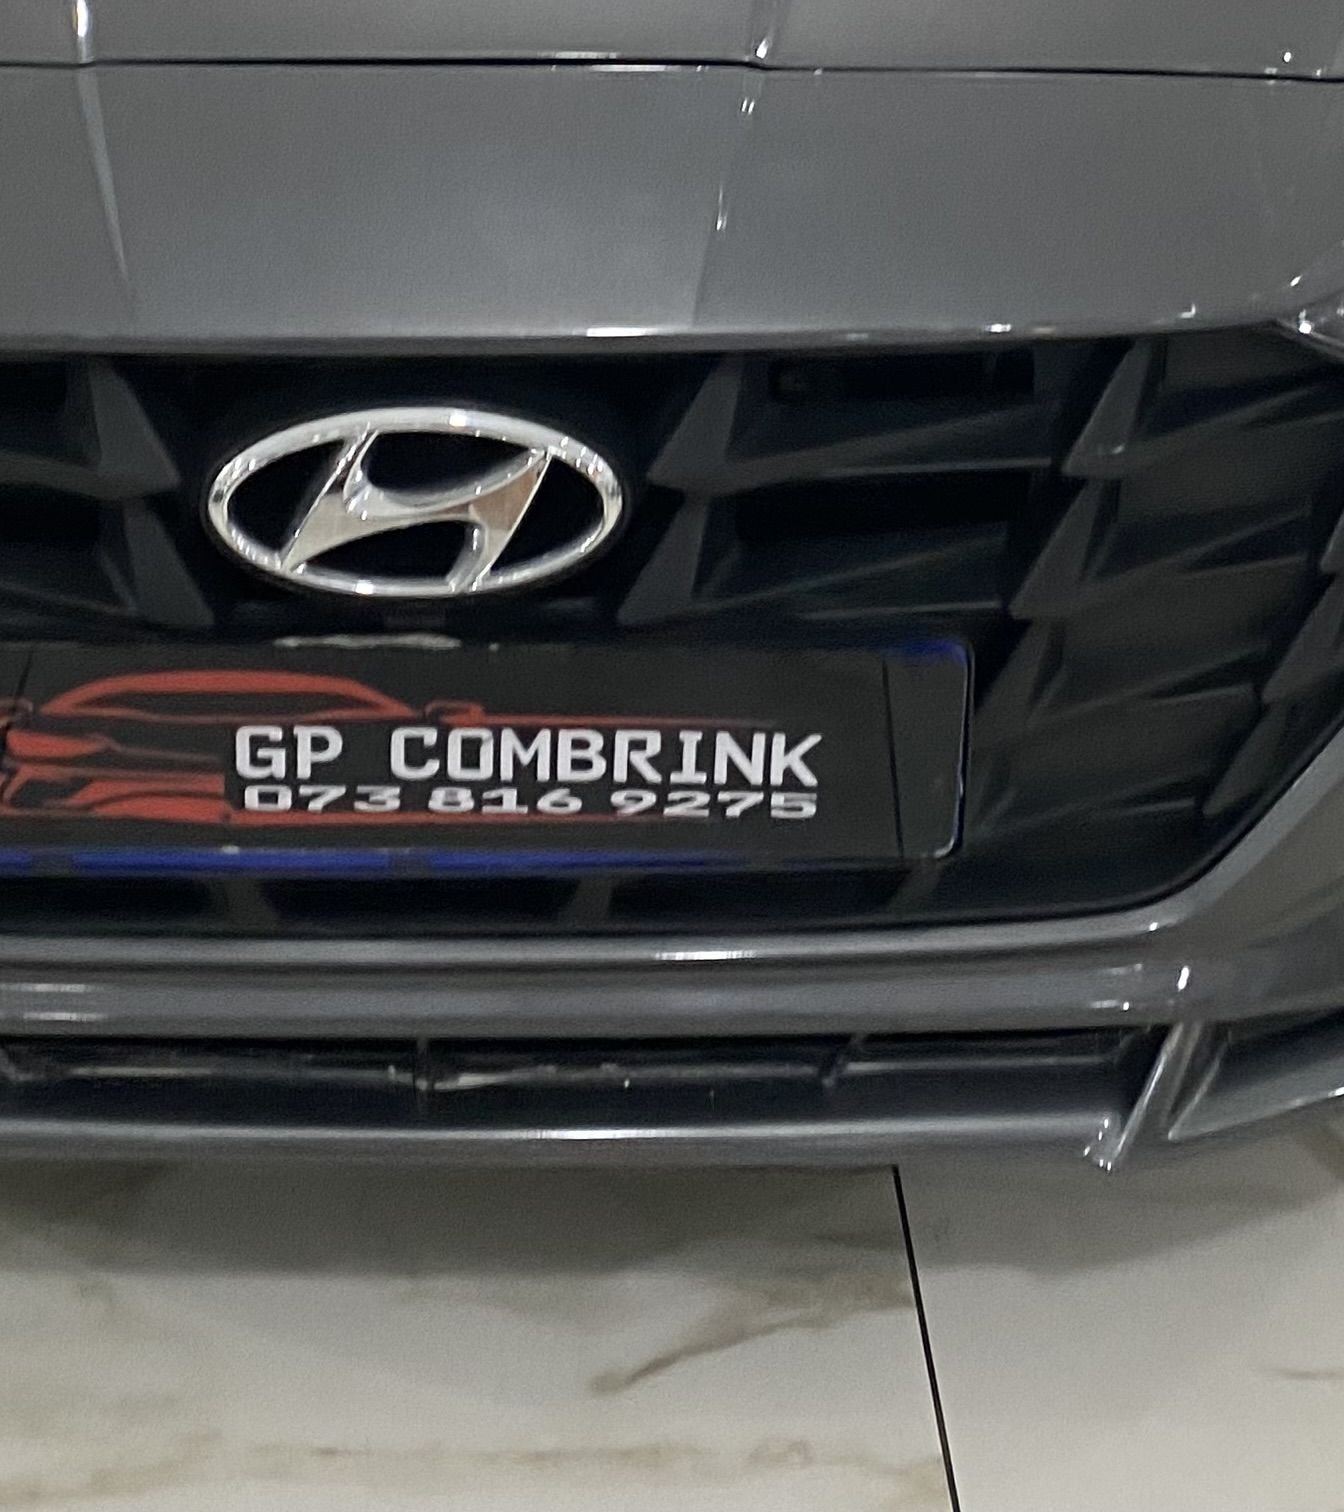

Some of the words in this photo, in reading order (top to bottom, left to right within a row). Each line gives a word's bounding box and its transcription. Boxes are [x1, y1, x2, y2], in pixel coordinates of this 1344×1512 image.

[234, 724, 344, 781] GP
[389, 725, 824, 787] COMBRINK
[242, 784, 402, 813] 073
[427, 785, 584, 815] 816
[609, 790, 819, 819] 9275
